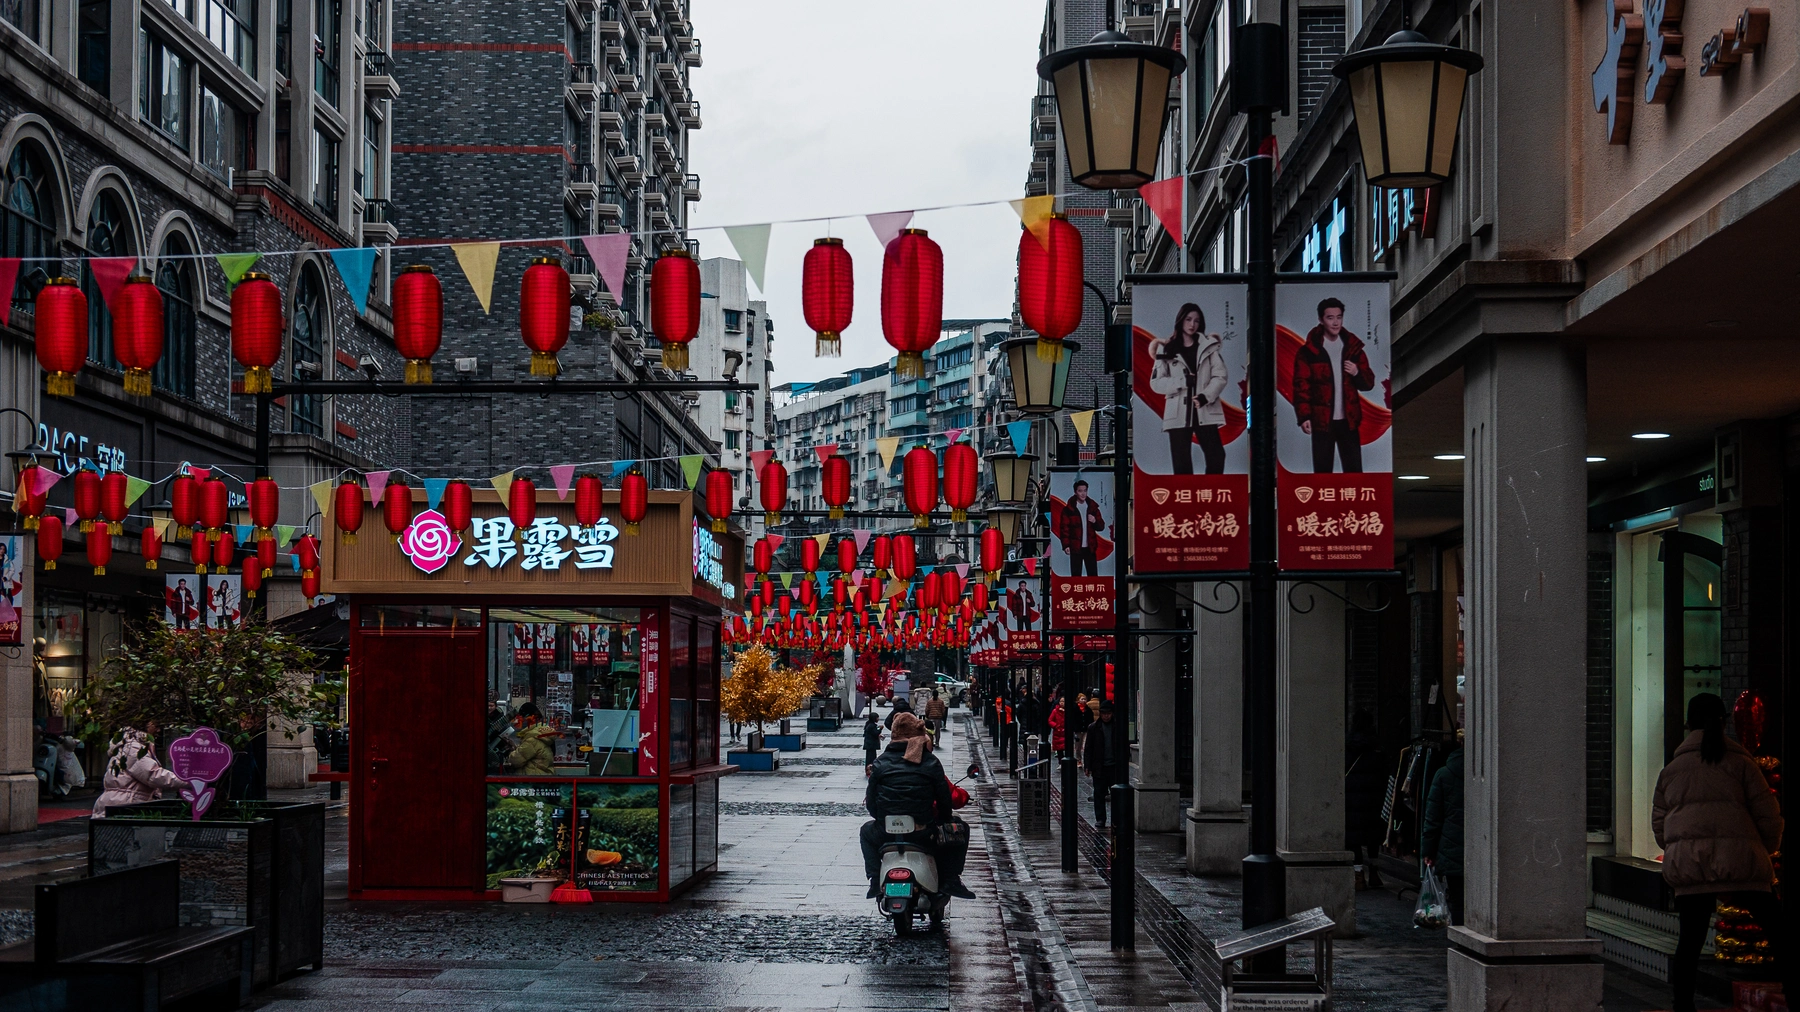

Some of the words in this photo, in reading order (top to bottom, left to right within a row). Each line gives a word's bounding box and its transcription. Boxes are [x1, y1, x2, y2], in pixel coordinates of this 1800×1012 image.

[1699, 474, 1714, 491] studio
[1174, 488, 1232, 503] 坦博尔
[1318, 487, 1376, 502] 坦博尔
[1152, 511, 1240, 539] 暖衣鸿福
[1296, 509, 1384, 537] 暖衣鸿福
[463, 516, 620, 570] 果露雪
